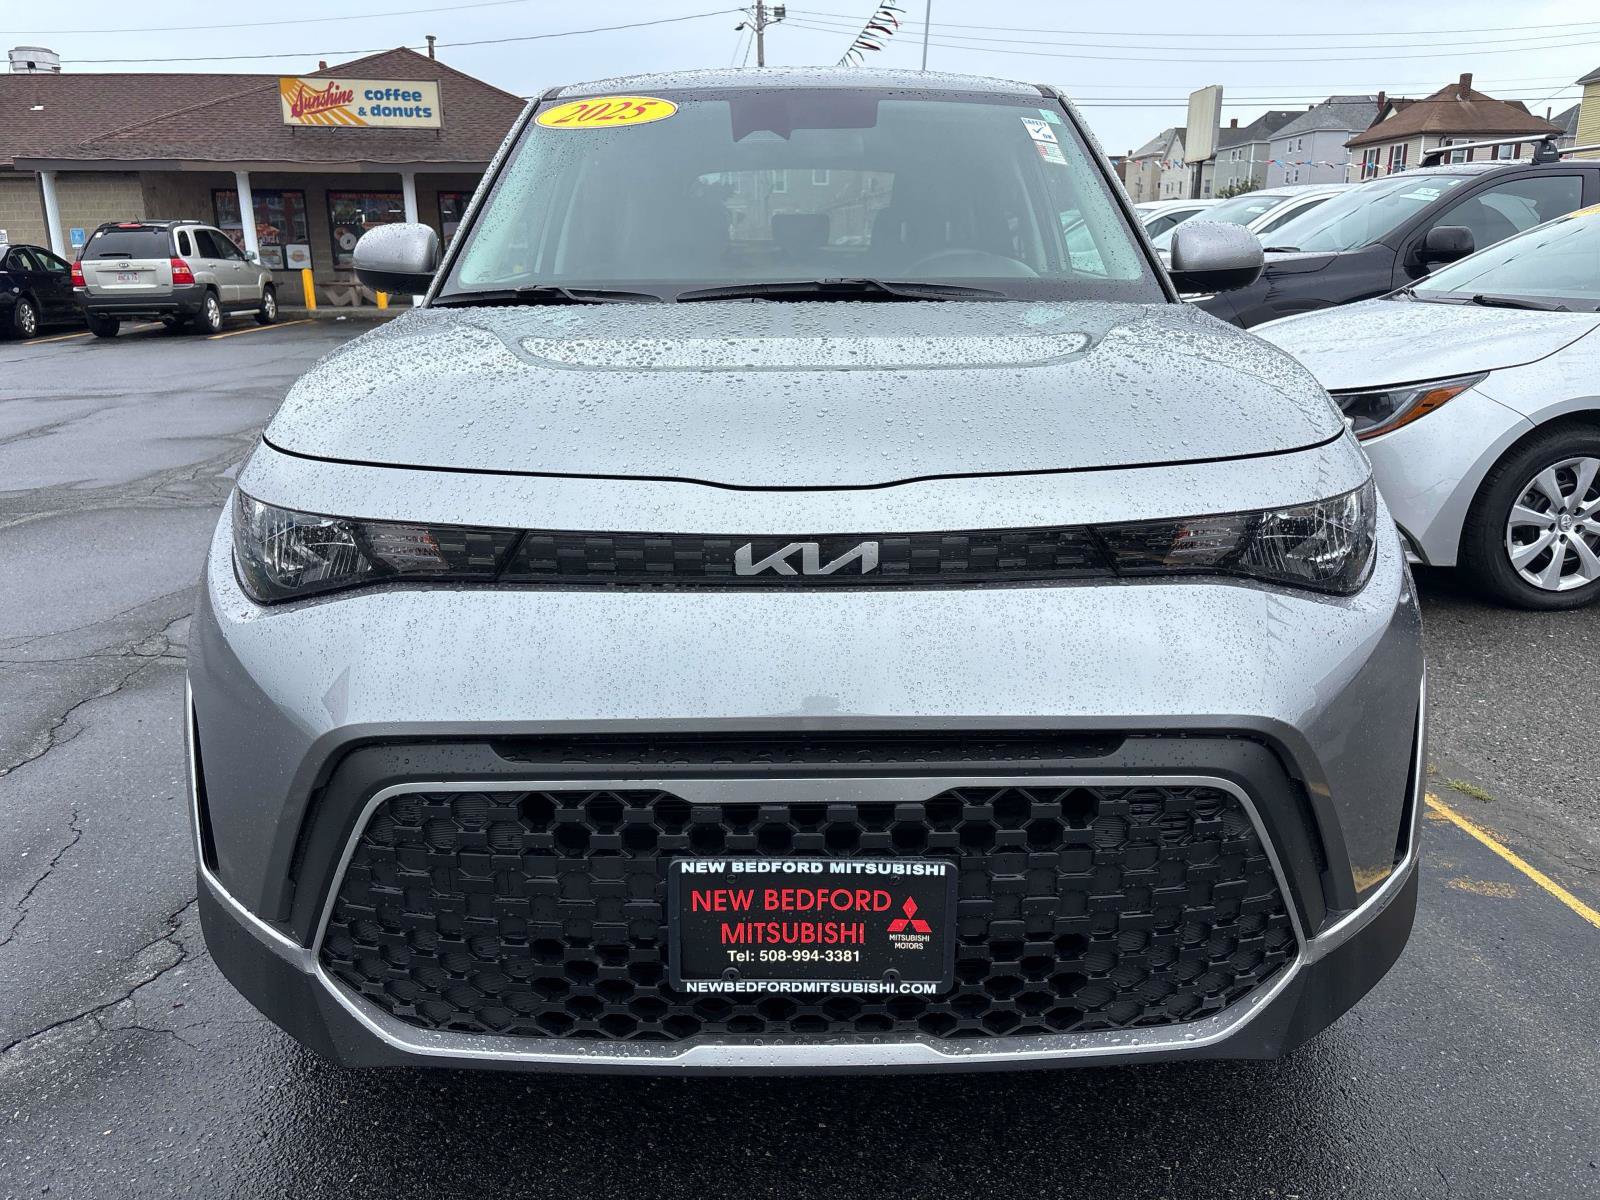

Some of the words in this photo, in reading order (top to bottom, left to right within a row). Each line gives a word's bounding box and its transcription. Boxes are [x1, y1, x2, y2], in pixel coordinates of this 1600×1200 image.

[291, 81, 354, 118] Sunshine
[364, 88, 422, 102] coffee
[358, 107, 367, 117] &
[370, 104, 432, 118] donuts
[553, 101, 658, 125] 2025
[735, 541, 878, 575] KIA
[681, 862, 726, 874] NEW
[731, 862, 823, 874] BEDFORD
[829, 863, 946, 876] MITSUBISHI
[691, 889, 754, 912] NEW
[764, 888, 892, 912] BEDFORD
[721, 922, 866, 944] MITSUBISHI
[889, 934, 930, 942] MITSUBISHI
[894, 942, 924, 950] MOTORS
[727, 950, 755, 962] Tel:
[759, 950, 860, 962] 508-994-3381
[686, 982, 937, 994] NEWBEDFORDMITSUBISHI.COM
